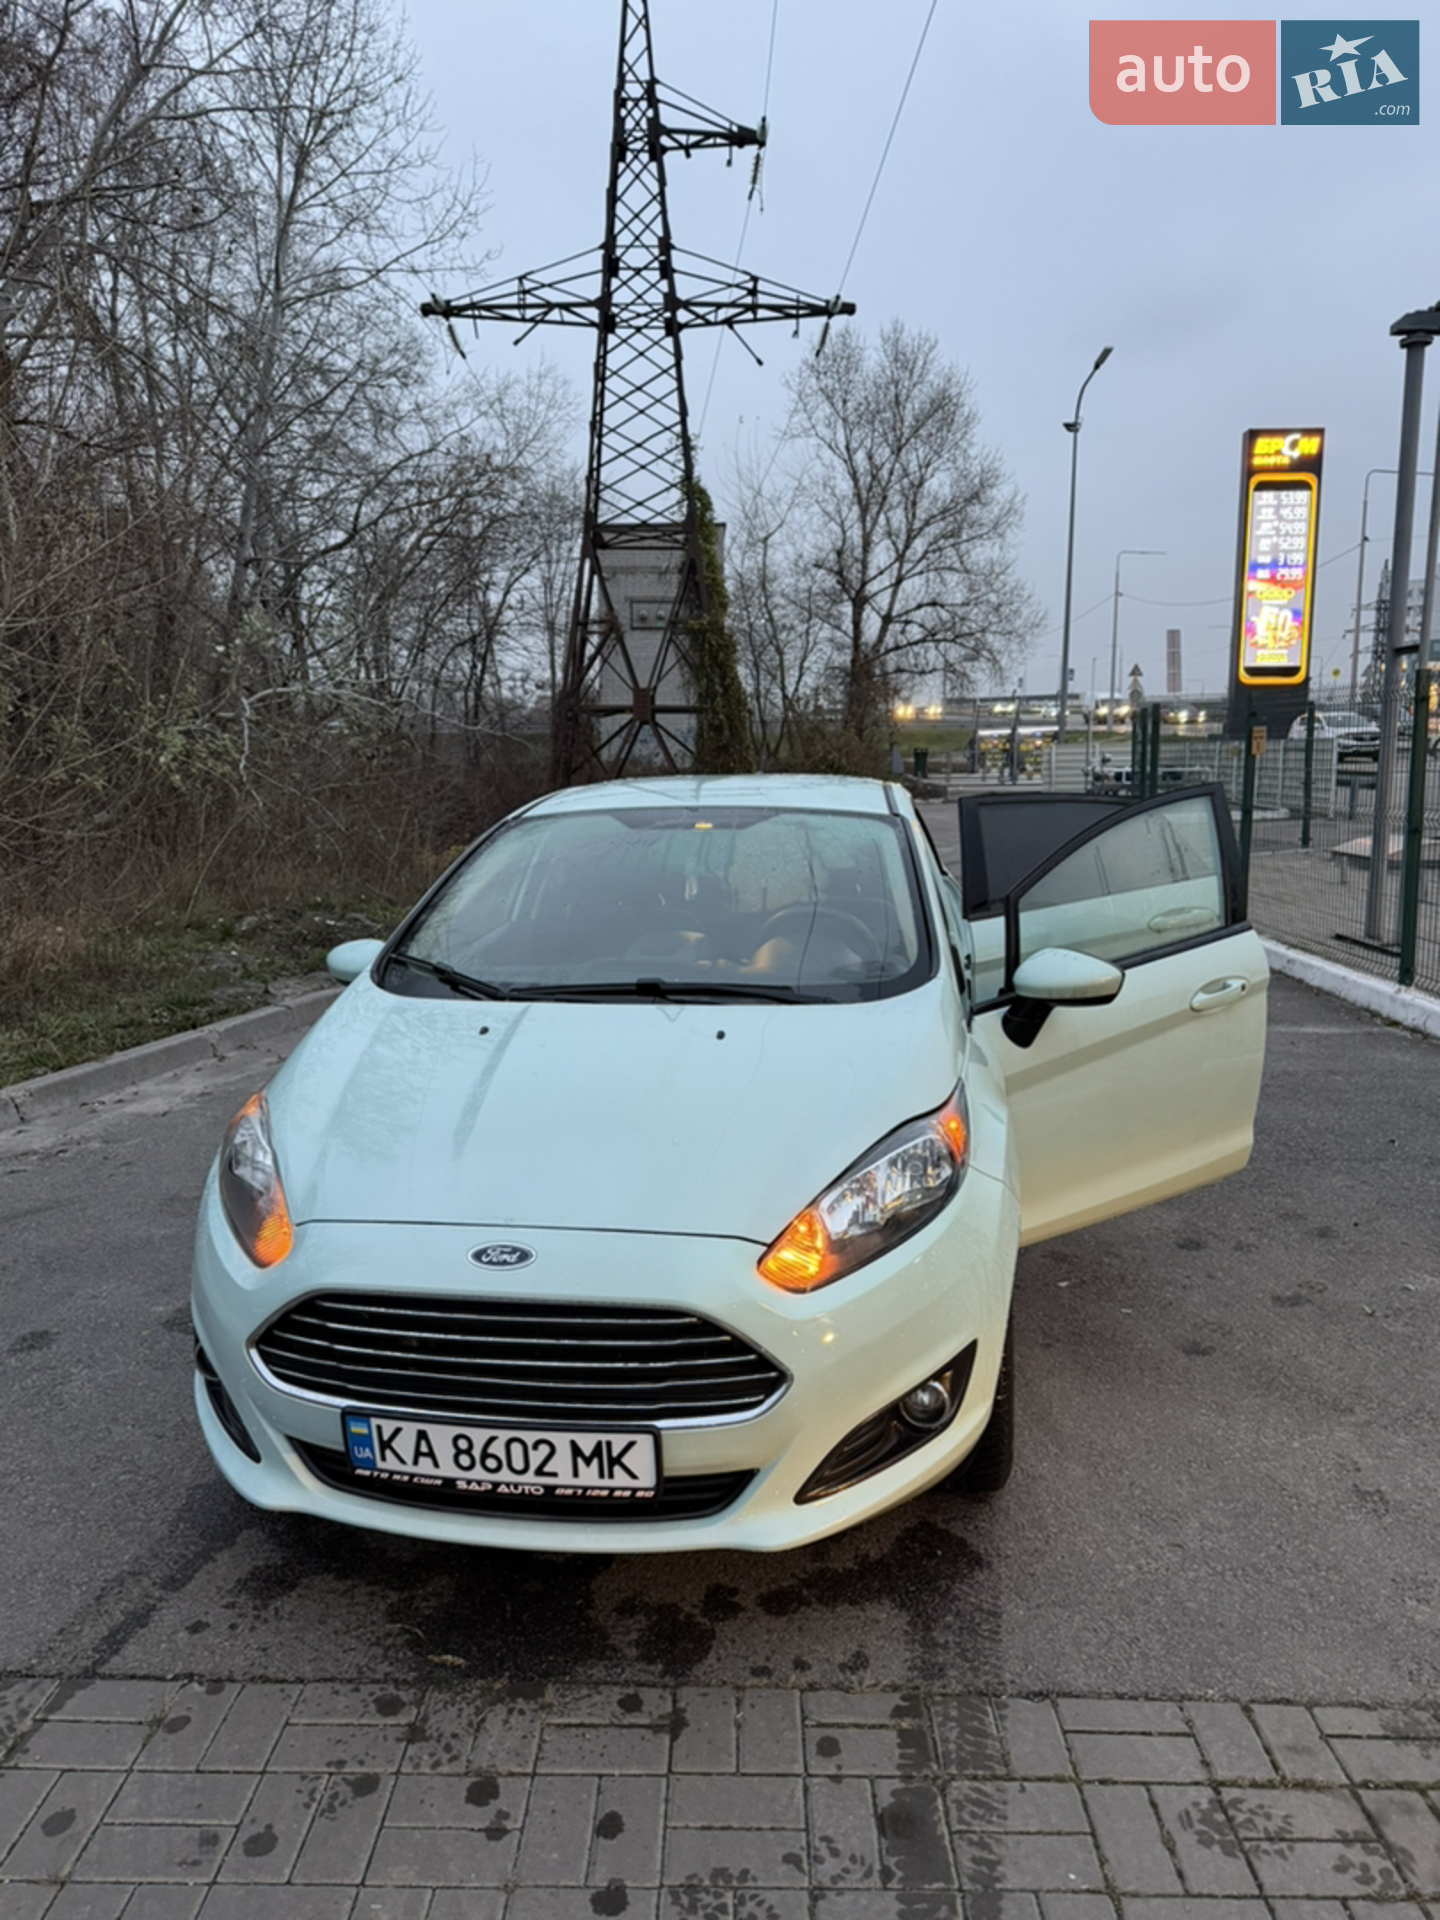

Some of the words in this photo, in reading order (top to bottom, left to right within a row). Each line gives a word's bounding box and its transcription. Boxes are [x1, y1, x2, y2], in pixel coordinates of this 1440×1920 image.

[481, 1248, 521, 1262] Ford
[354, 1446, 373, 1459] UA
[375, 1424, 440, 1469] KA
[451, 1433, 559, 1478] 8602
[570, 1439, 640, 1480] MK
[496, 1484, 544, 1495] AUTO
